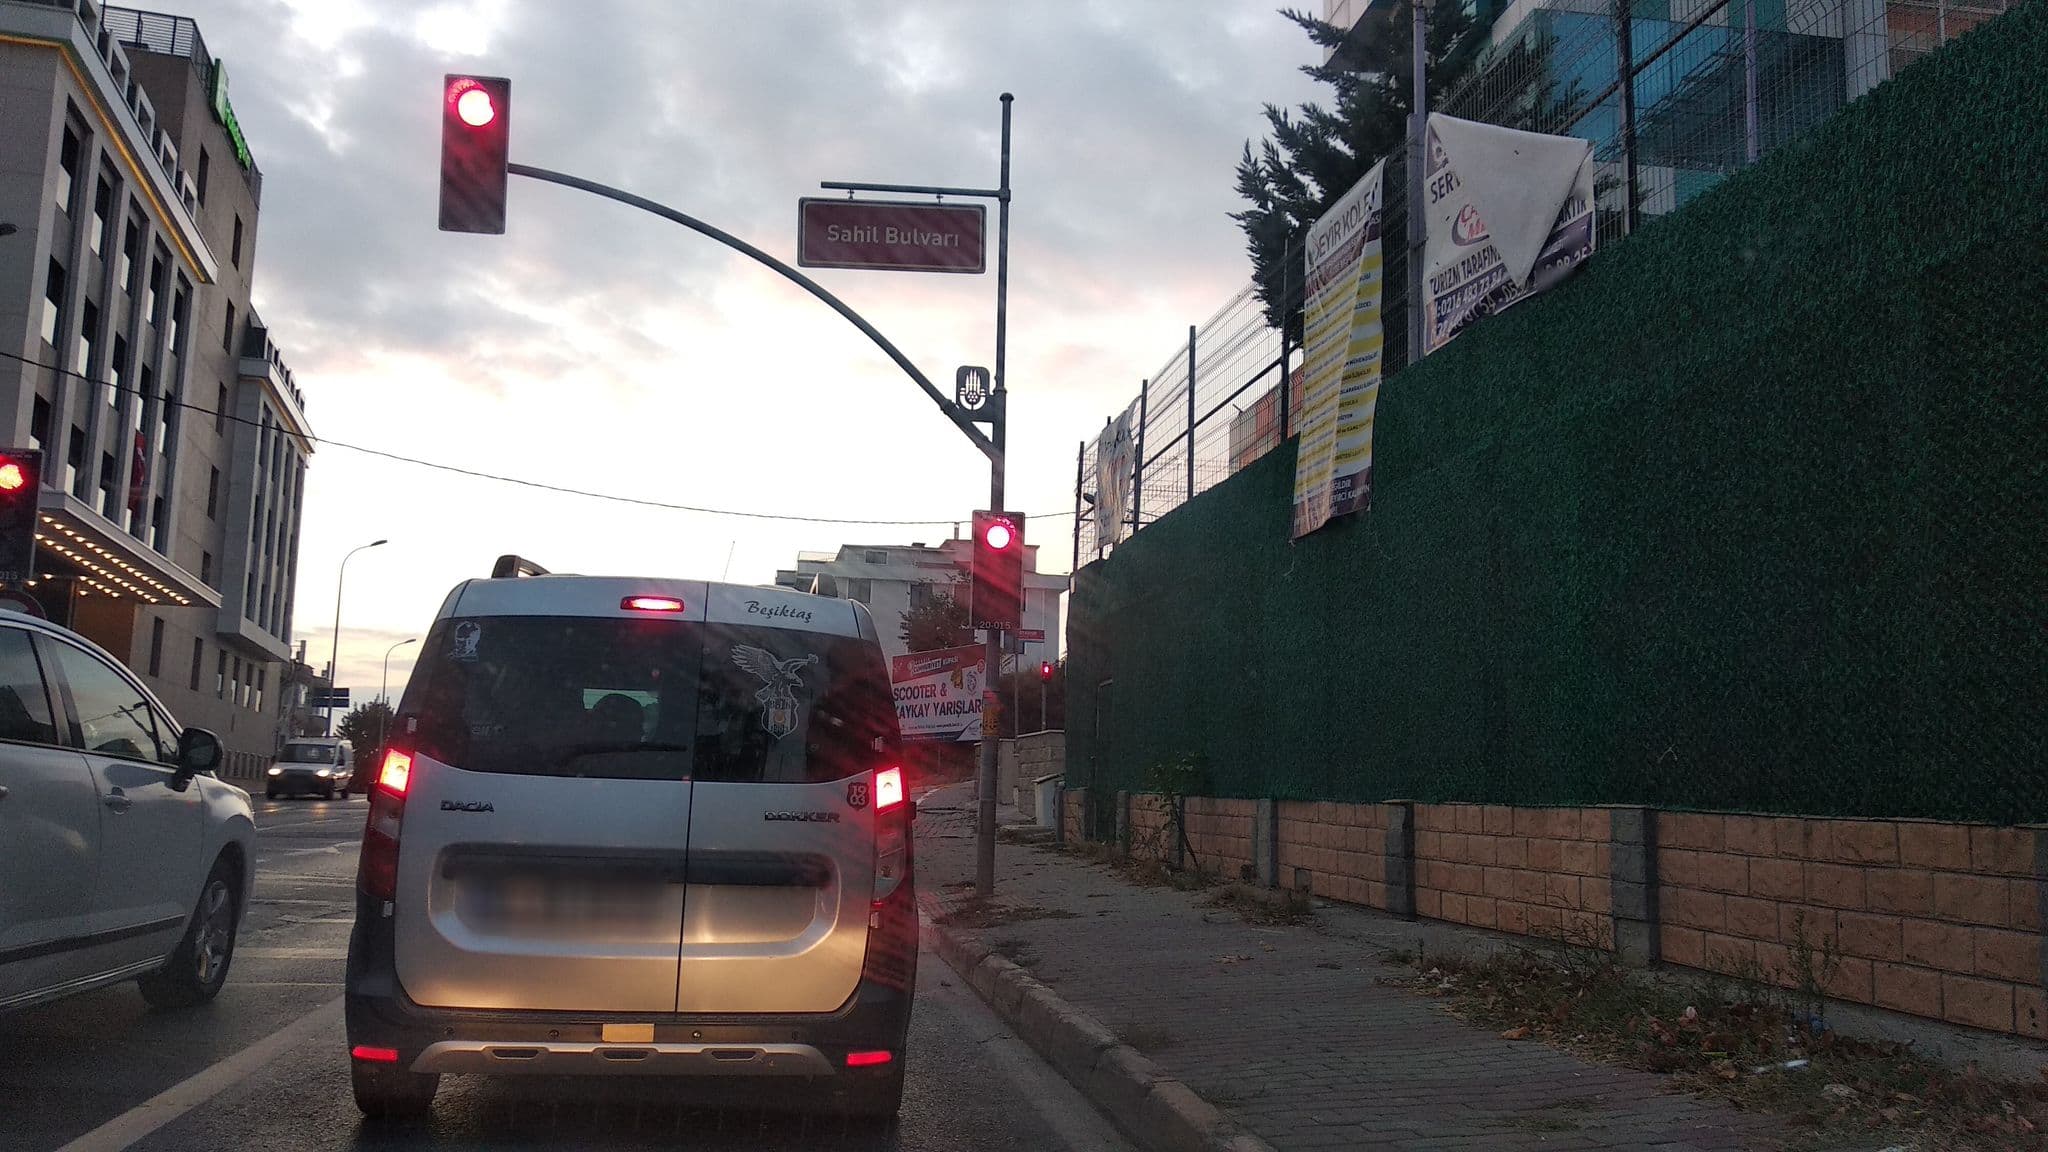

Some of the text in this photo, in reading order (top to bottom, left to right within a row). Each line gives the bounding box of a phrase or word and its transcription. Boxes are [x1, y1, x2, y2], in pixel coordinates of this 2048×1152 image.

[827, 224, 959, 247] Sahil Bulvarı
[743, 600, 813, 623] Beşiktaş
[979, 620, 1012, 630] 20-015
[893, 682, 947, 702] SCOOTER &
[440, 799, 495, 813] DACIA
[764, 810, 840, 823] DOKKER
